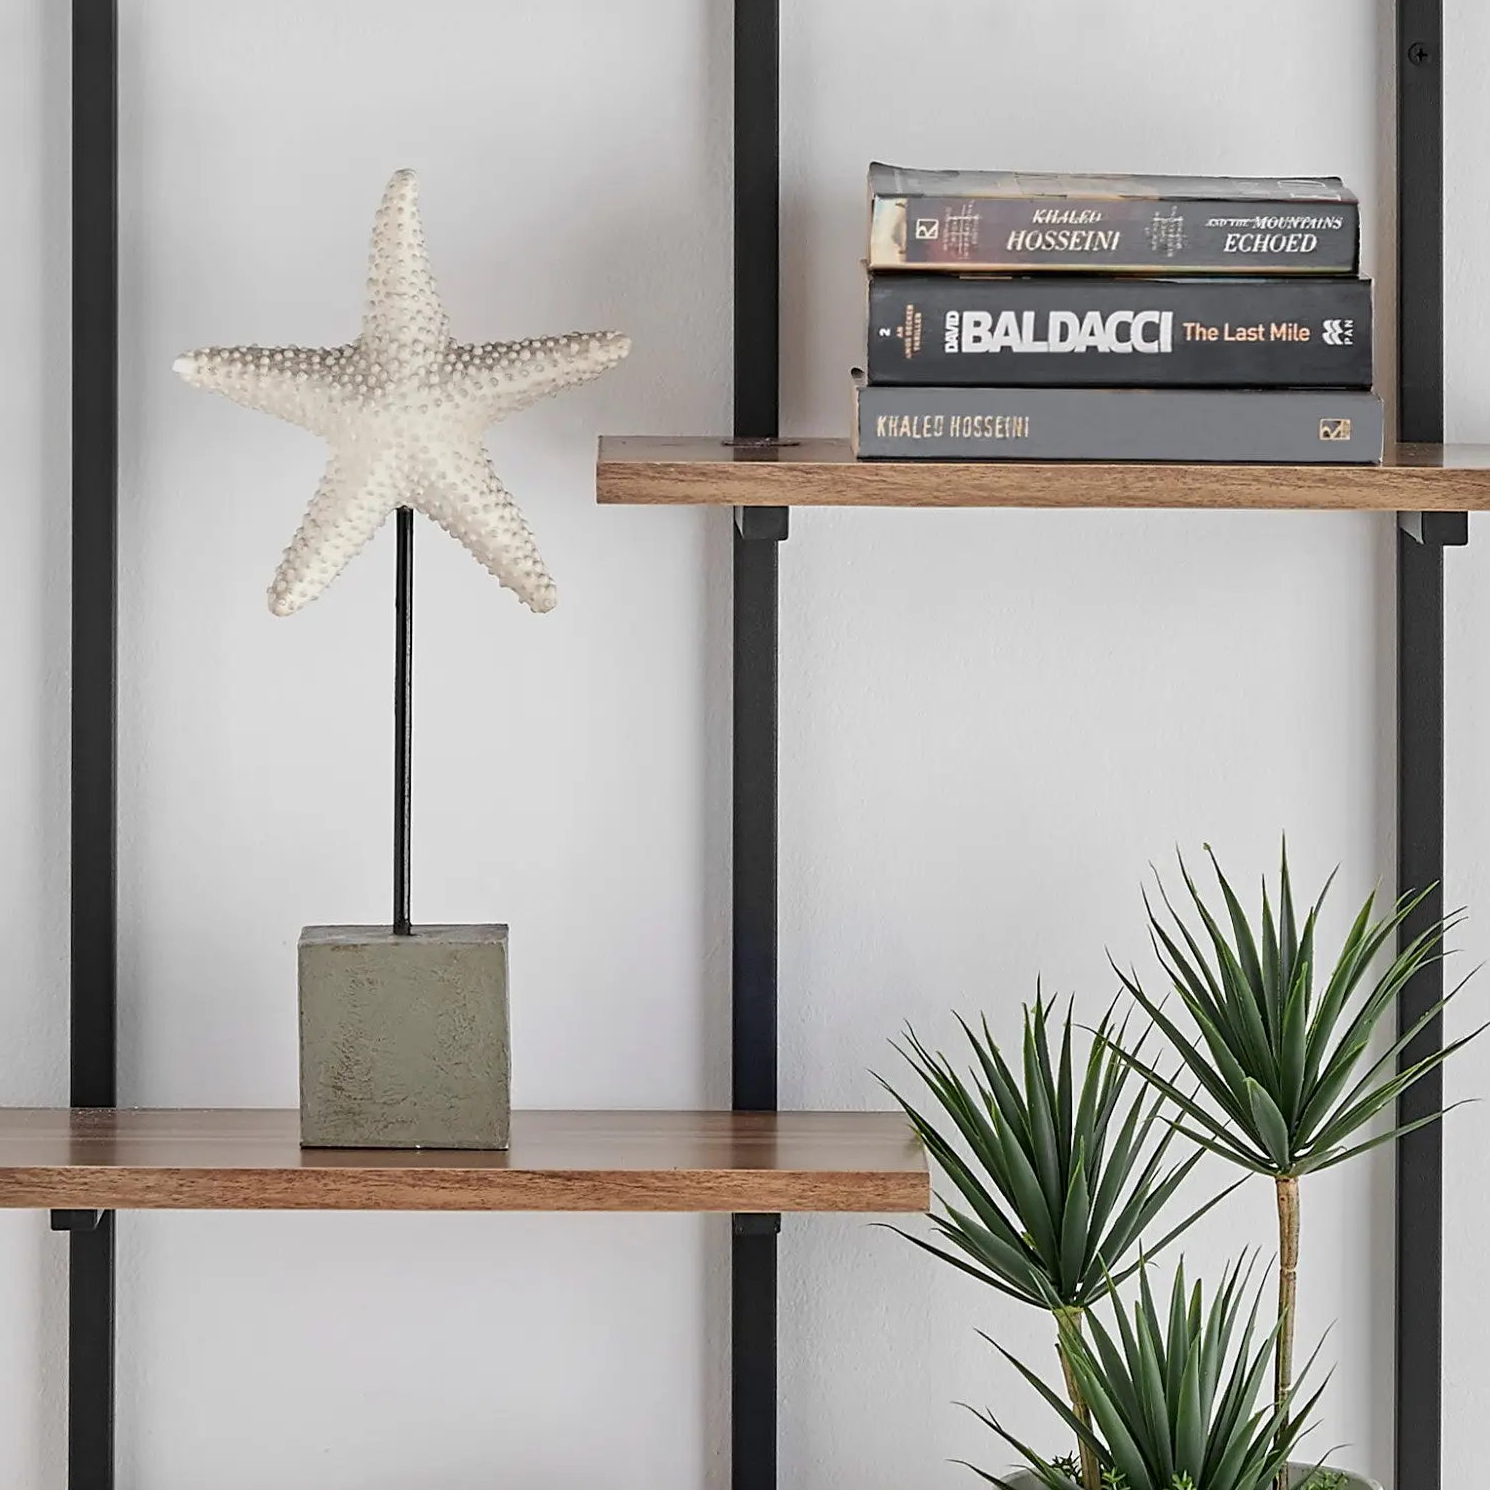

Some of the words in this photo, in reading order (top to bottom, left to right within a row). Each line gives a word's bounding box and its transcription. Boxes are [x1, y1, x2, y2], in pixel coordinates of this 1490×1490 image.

[1032, 209, 1103, 224] KHALED
[1252, 216, 1343, 229] MOUNTAINS
[1006, 231, 1121, 251] HOSSEINI
[1223, 232, 1318, 252] ECHOED
[879, 327, 891, 337] 2
[945, 310, 960, 353] DAVID
[961, 310, 1173, 353] BALDACCI
[1183, 322, 1219, 341] The
[1223, 322, 1265, 341] Last
[1270, 322, 1311, 341] Mile
[1344, 319, 1354, 346] PAN
[876, 415, 945, 439] KHALED
[950, 415, 1030, 439] HOSSEINI
